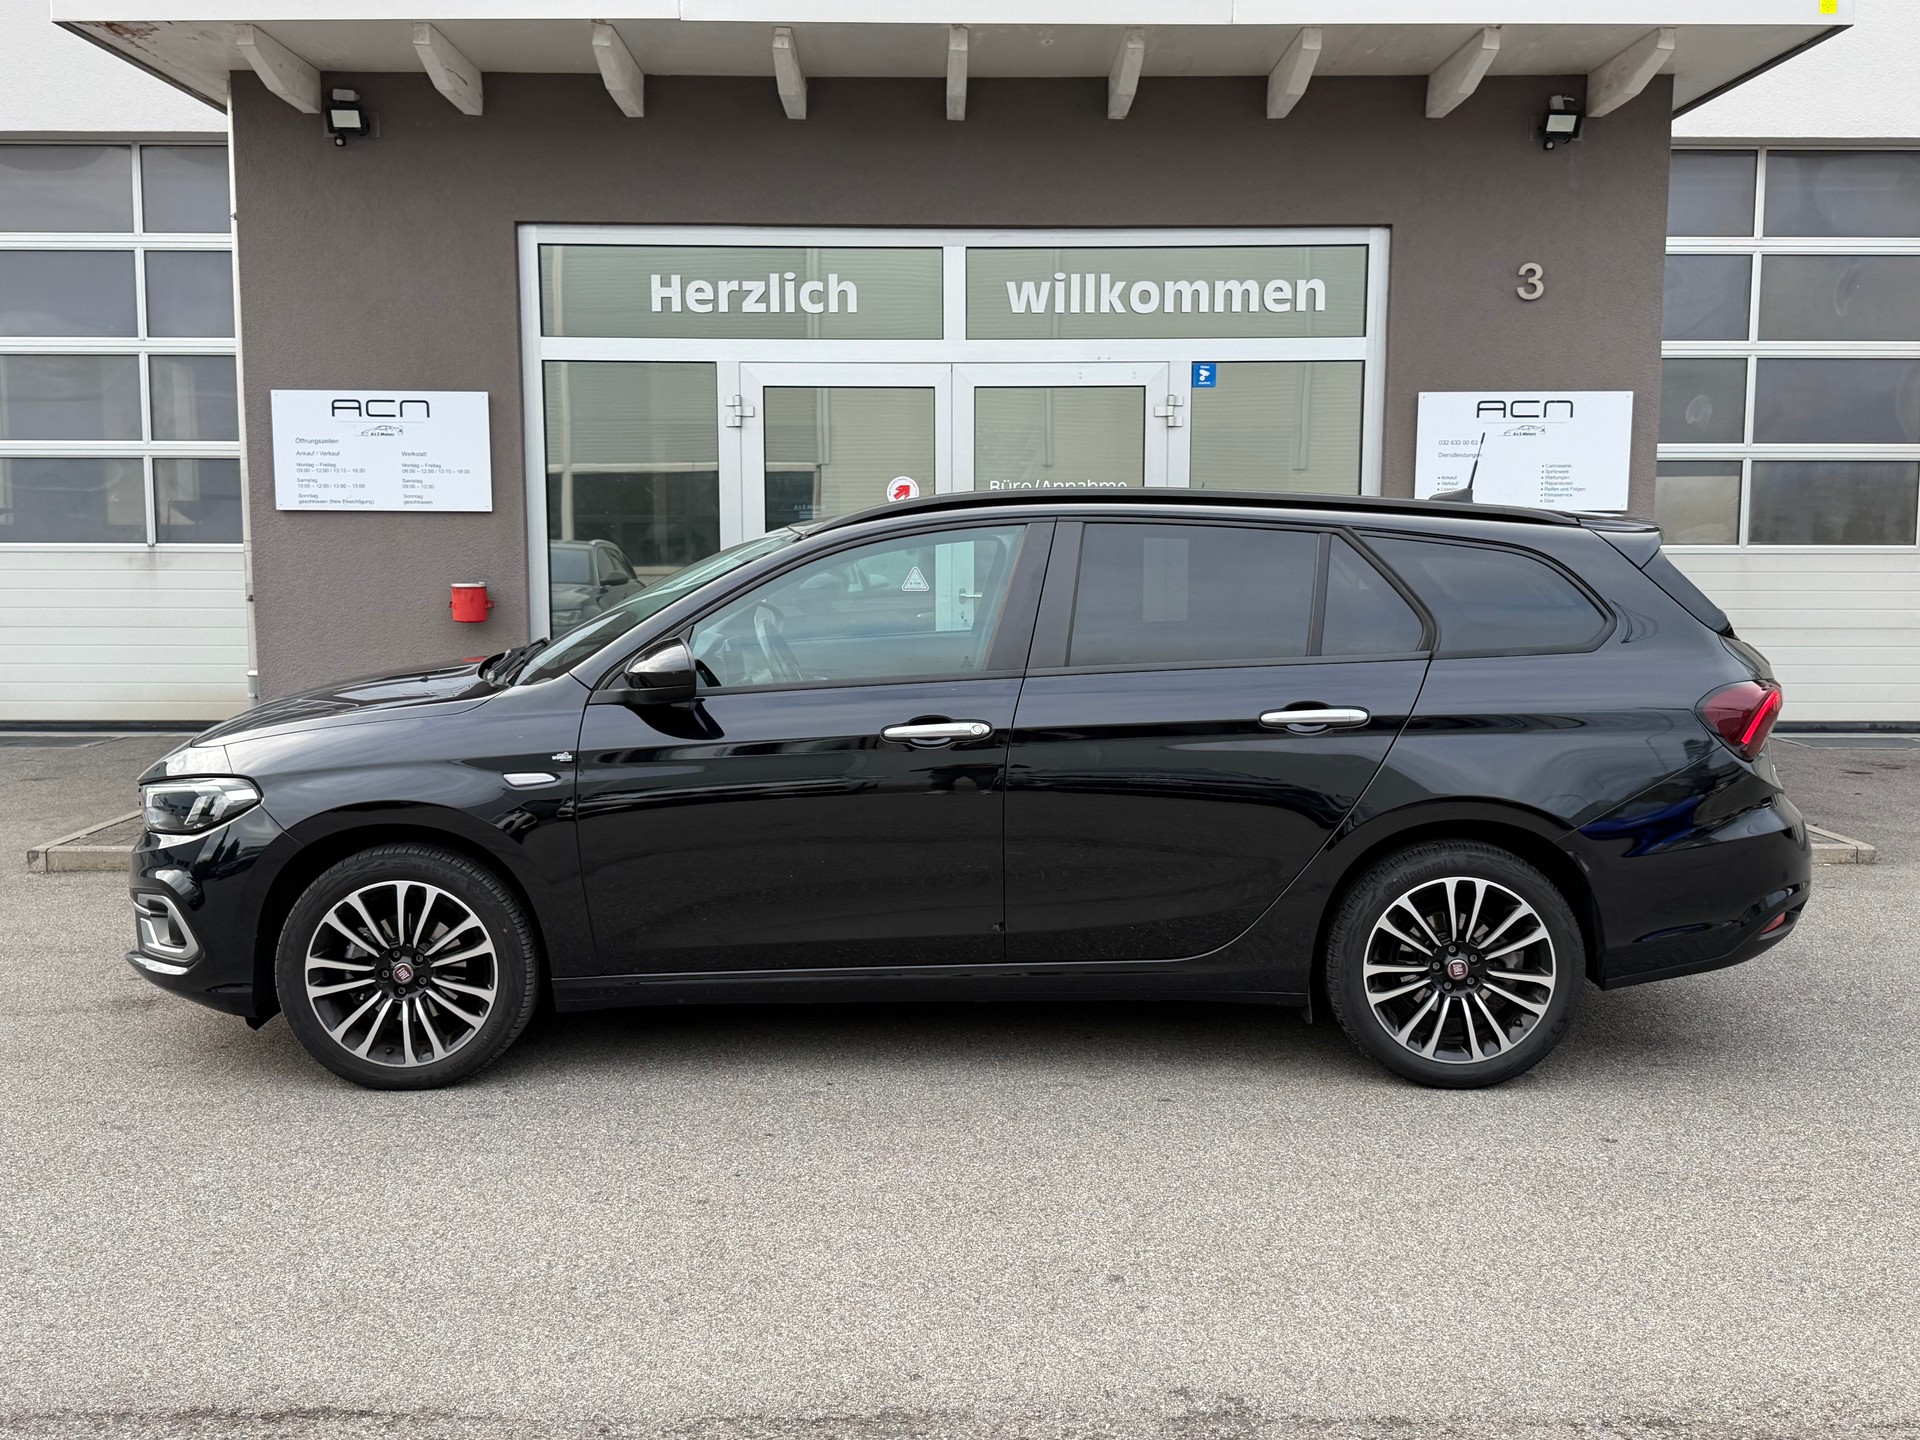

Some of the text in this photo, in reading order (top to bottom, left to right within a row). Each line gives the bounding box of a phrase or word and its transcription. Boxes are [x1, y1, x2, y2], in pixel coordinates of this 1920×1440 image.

[1516, 262, 1544, 300] 3
[651, 272, 1326, 314] Herzlich willkommen
[332, 399, 430, 418] ACN
[1476, 400, 1574, 418] ACN
[295, 437, 339, 445] Öffnungszeiten
